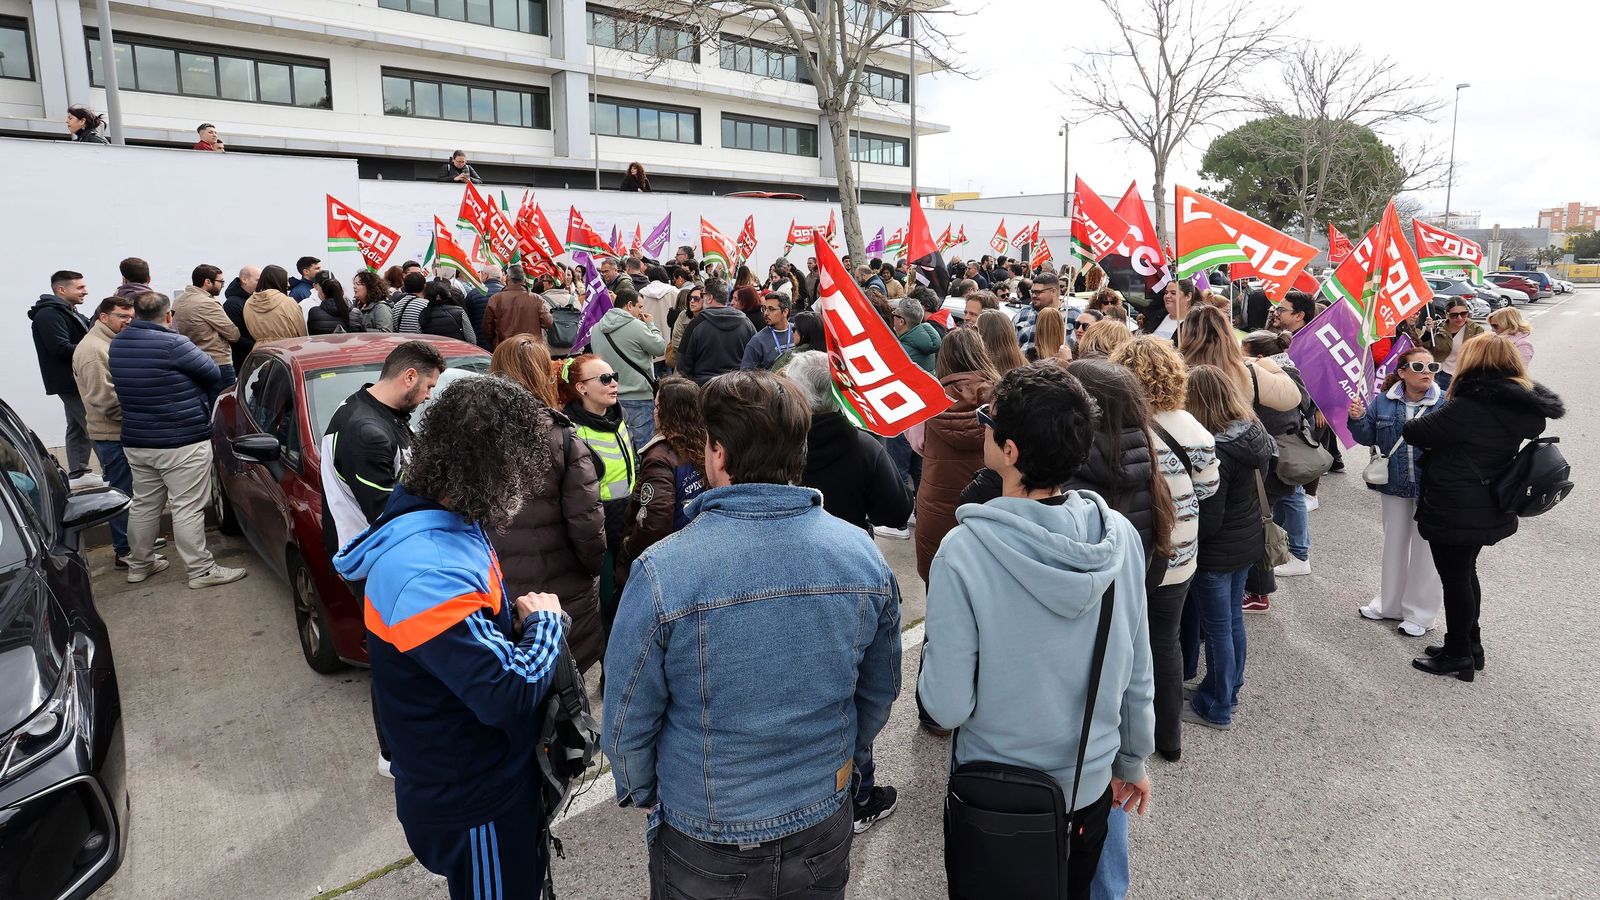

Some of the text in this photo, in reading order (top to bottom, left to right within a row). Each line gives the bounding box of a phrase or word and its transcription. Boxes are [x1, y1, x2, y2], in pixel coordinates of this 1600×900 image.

[332, 202, 394, 254] CCOO
[490, 205, 518, 251] COO
[357, 240, 383, 265] Cádiz
[1116, 224, 1172, 294] CGT
[1379, 286, 1395, 329] diz
[1338, 379, 1358, 402] And
